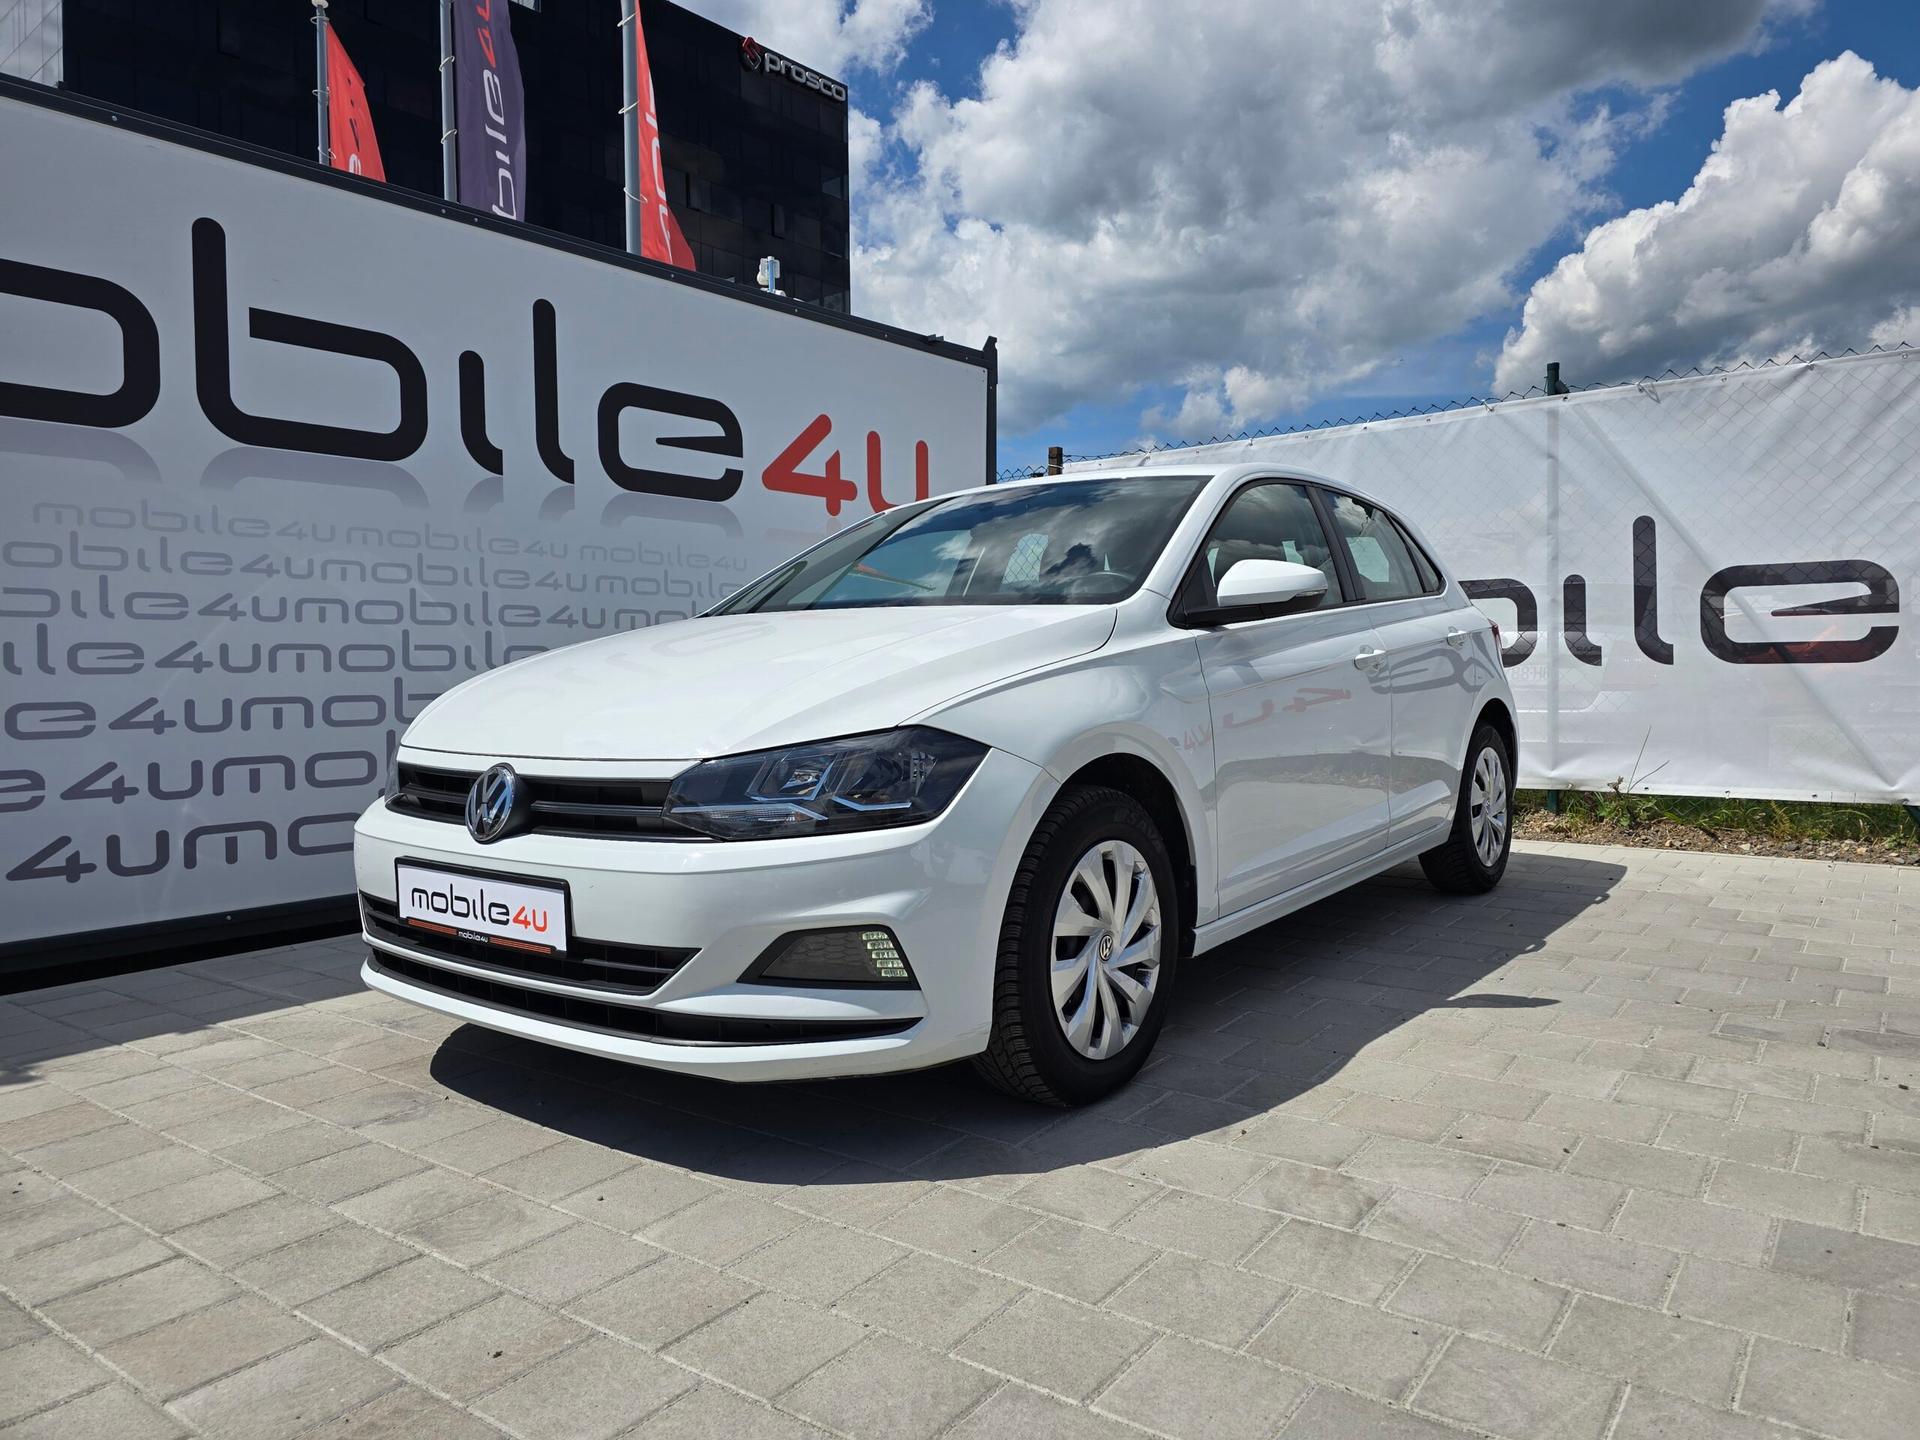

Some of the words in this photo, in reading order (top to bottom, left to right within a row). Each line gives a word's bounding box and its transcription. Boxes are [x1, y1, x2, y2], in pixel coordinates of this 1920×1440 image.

[764, 52, 846, 102] prosco
[33, 498, 336, 543] mobile4u
[346, 522, 568, 557] mobile4u
[580, 540, 748, 572] mobile4u
[411, 884, 548, 933] mobile4u
[458, 930, 489, 944] mobile4u
